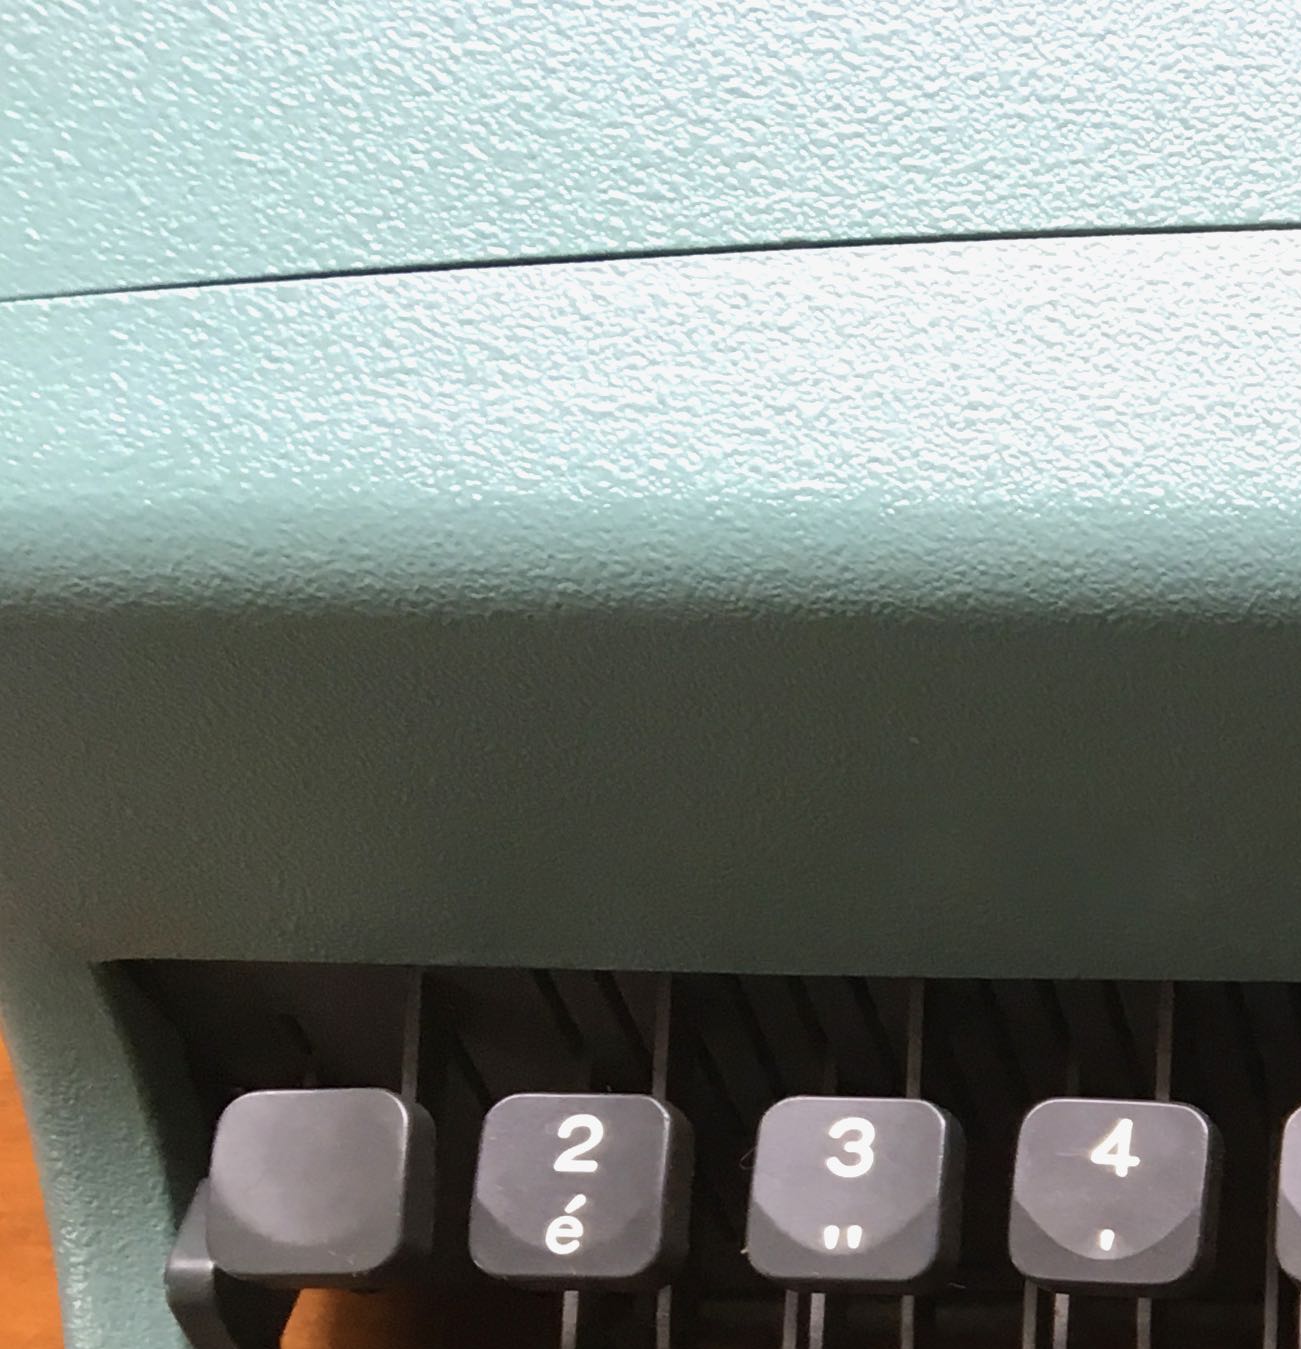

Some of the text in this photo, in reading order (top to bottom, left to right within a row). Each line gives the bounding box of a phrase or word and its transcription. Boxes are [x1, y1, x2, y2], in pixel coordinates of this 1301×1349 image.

[553, 1113, 604, 1173] 2
[825, 1116, 876, 1178] 3
[1089, 1118, 1141, 1178] 4
[544, 1193, 587, 1255] é
